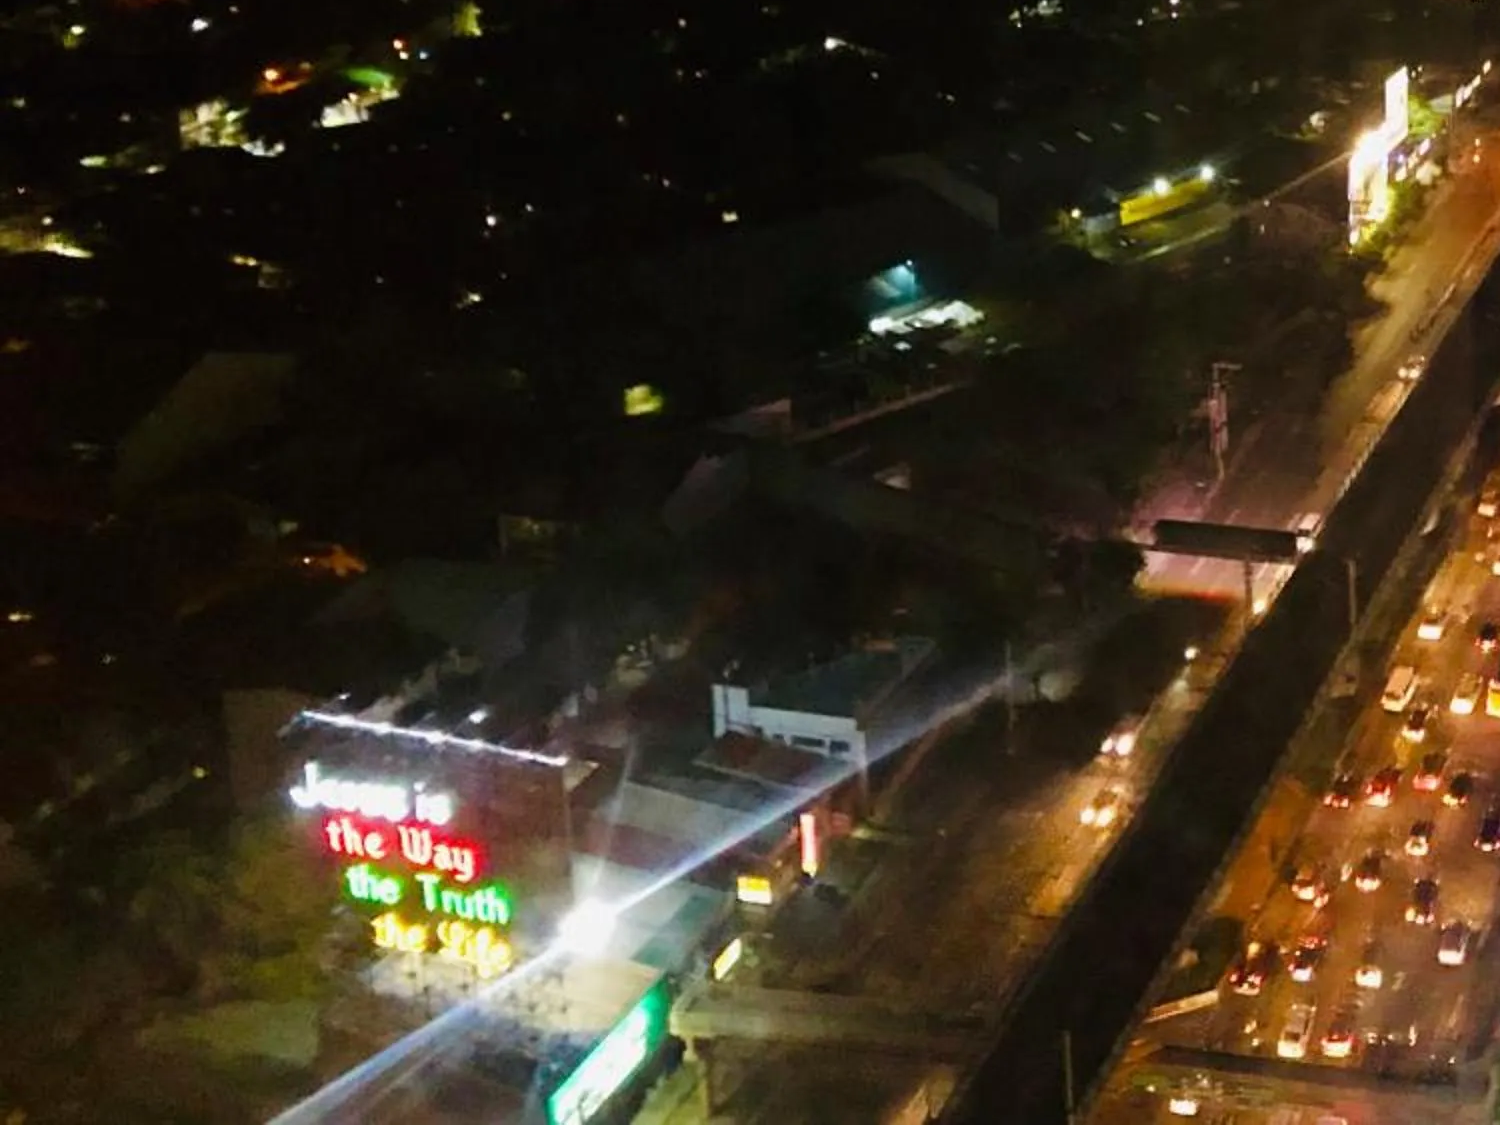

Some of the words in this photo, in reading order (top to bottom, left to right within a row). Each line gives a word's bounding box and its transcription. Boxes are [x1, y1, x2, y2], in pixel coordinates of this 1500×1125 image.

[325, 818, 387, 861] the
[398, 824, 476, 883] Way
[345, 862, 401, 904] the
[415, 872, 512, 926] Truth
[370, 910, 428, 954] the
